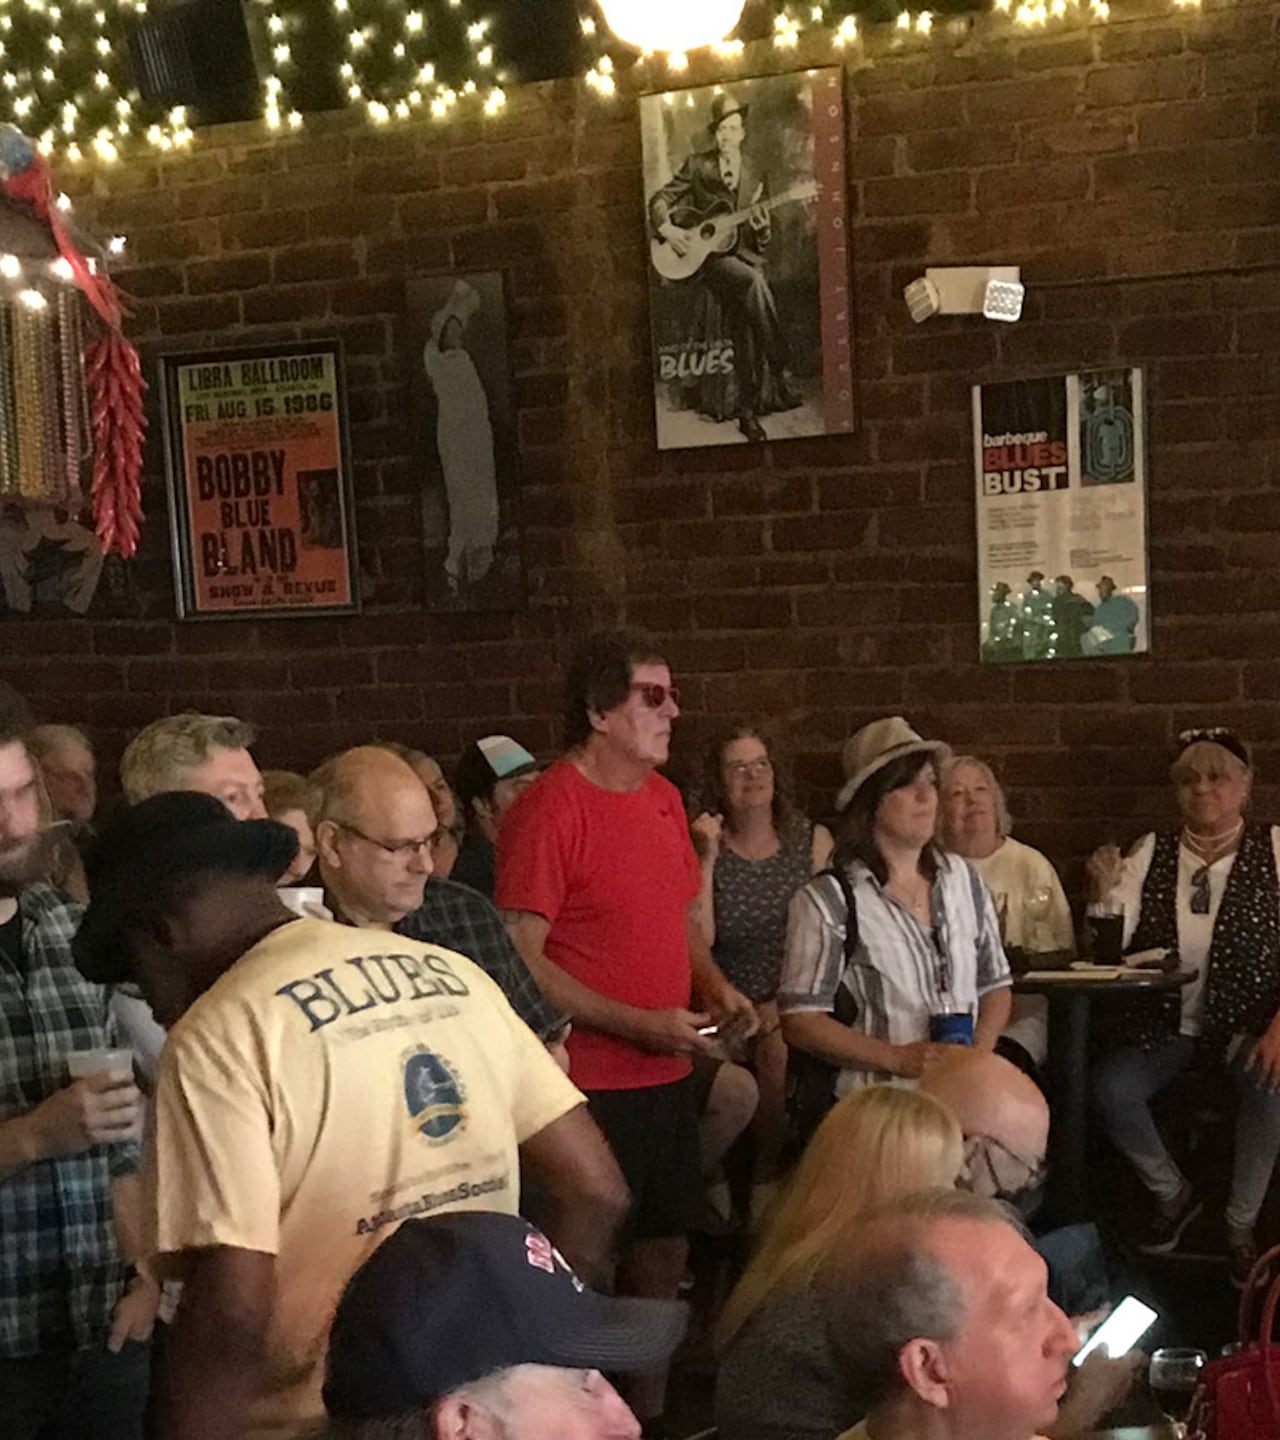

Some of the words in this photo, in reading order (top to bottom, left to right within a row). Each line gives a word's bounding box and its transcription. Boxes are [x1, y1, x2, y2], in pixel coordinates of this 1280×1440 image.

[188, 366, 233, 392] LIBRA
[241, 357, 324, 387] BALLROOM
[659, 348, 734, 381] BLUES
[284, 393, 333, 415] 1986
[984, 431, 1047, 447] barbeque
[984, 442, 1066, 470] BLUES
[196, 450, 286, 500] BOBBY
[984, 466, 1066, 495] BUST
[221, 502, 271, 529] BLUE
[201, 528, 297, 577] BLAND
[275, 953, 470, 1033] BLUES
